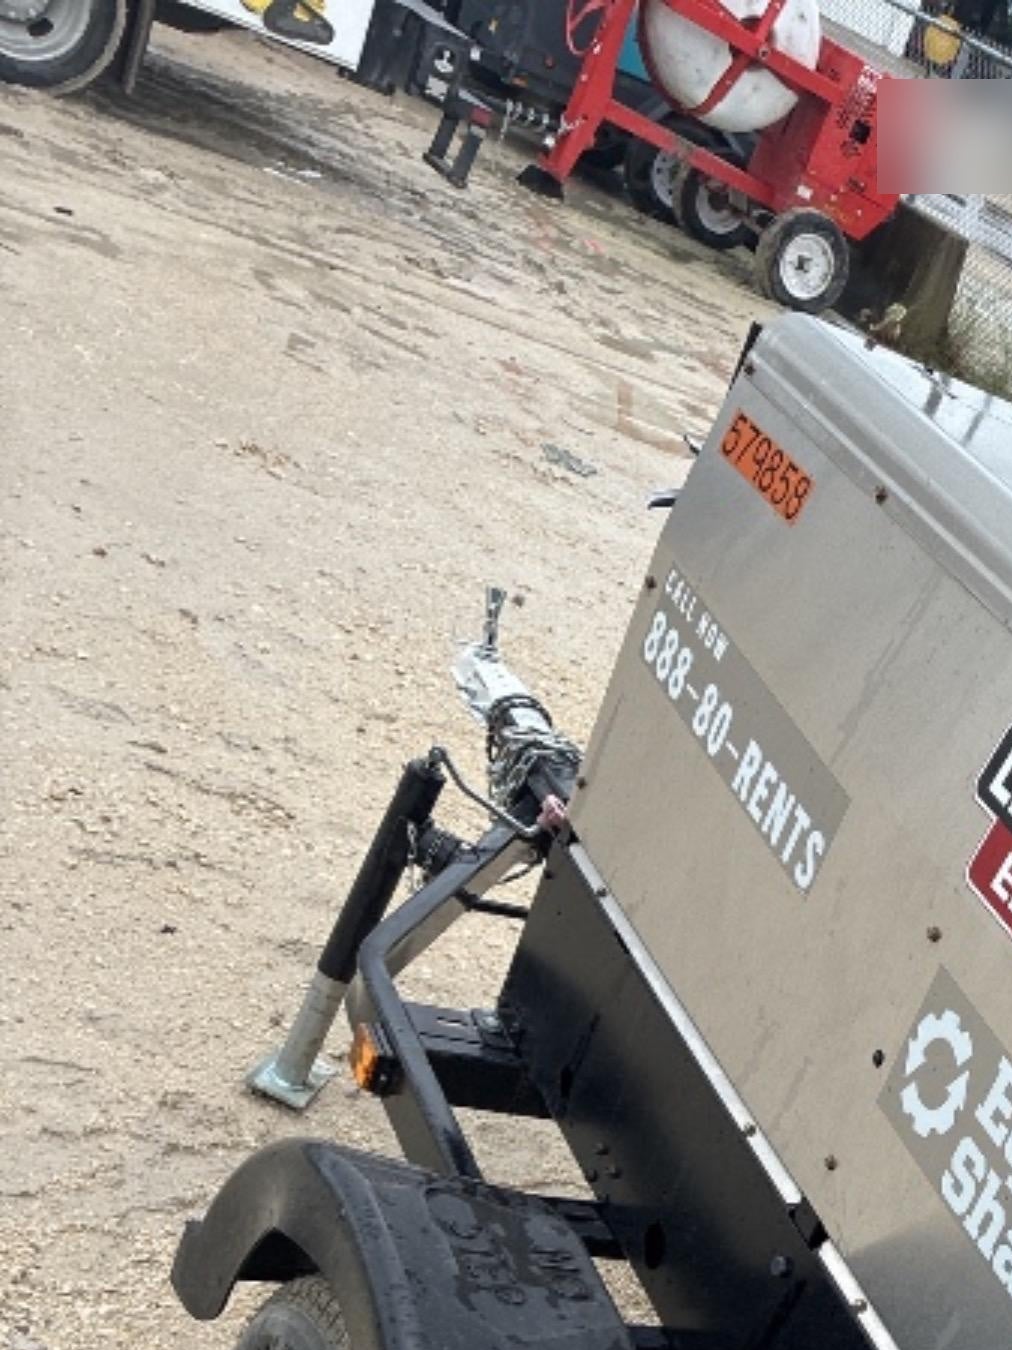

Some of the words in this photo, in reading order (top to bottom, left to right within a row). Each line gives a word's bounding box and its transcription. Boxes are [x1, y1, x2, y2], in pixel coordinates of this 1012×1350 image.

[721, 414, 809, 520] 579858
[664, 568, 697, 623] CALL
[643, 611, 826, 889] 888-80-RENTS
